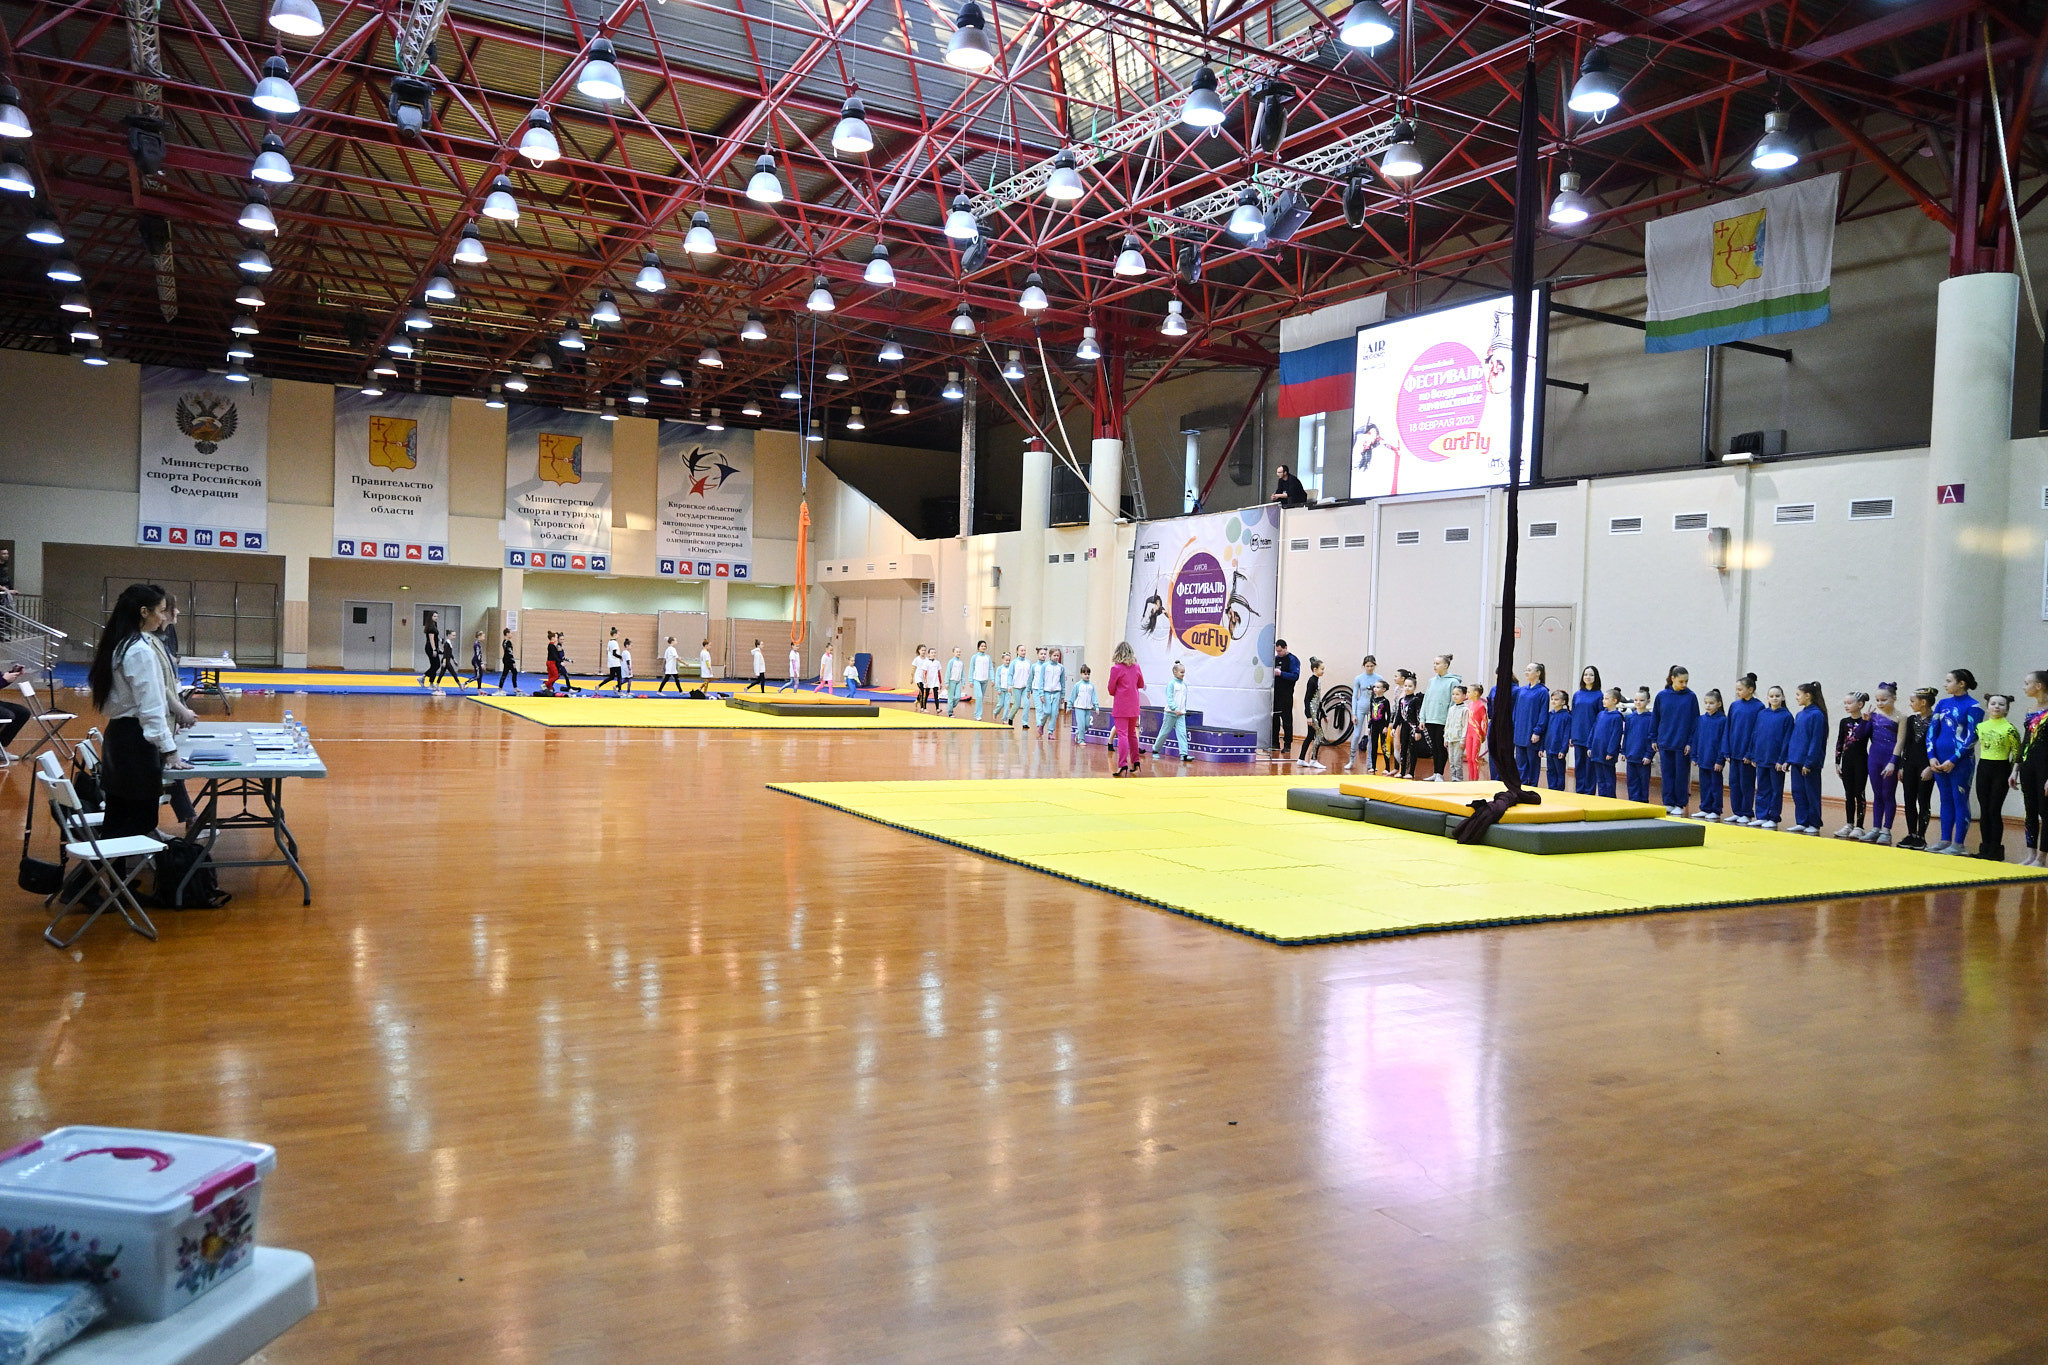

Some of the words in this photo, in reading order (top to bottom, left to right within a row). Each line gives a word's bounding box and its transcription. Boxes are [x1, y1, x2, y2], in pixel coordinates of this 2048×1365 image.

[1403, 365, 1484, 393] ФЕСТИВАЛЬ
[1419, 392, 1430, 401] по
[1409, 423, 1418, 432] 18
[1418, 417, 1455, 431] ФЕВРАЛЯ
[1455, 415, 1475, 426] 2023
[1442, 431, 1491, 455] artFly
[161, 456, 249, 472] Министерство
[146, 471, 189, 481] спорта
[192, 473, 262, 487] Российской
[351, 475, 434, 490] Правительство
[170, 484, 239, 499] Федерации
[362, 490, 422, 503] Кировской
[1942, 486, 1957, 503] A
[525, 494, 594, 507] Министерство
[370, 505, 414, 516] области
[518, 507, 551, 516] спорта
[561, 510, 600, 519] туризма
[668, 501, 707, 510] Кировское
[707, 503, 743, 514] областное
[676, 512, 735, 521] государственное
[533, 518, 585, 530] Кировской
[662, 519, 705, 529] автономное
[705, 522, 748, 532] учреждение
[540, 531, 578, 541] области
[717, 532, 740, 540] школа
[665, 537, 715, 546] олимпийского
[716, 541, 743, 549] резерва
[687, 546, 722, 555] «Юность»
[1176, 581, 1225, 597] ФЕСТИВАЛЬ
[1185, 597, 1193, 605] по
[1191, 628, 1229, 653] artFly
[1089, 715, 1094, 725] 2
